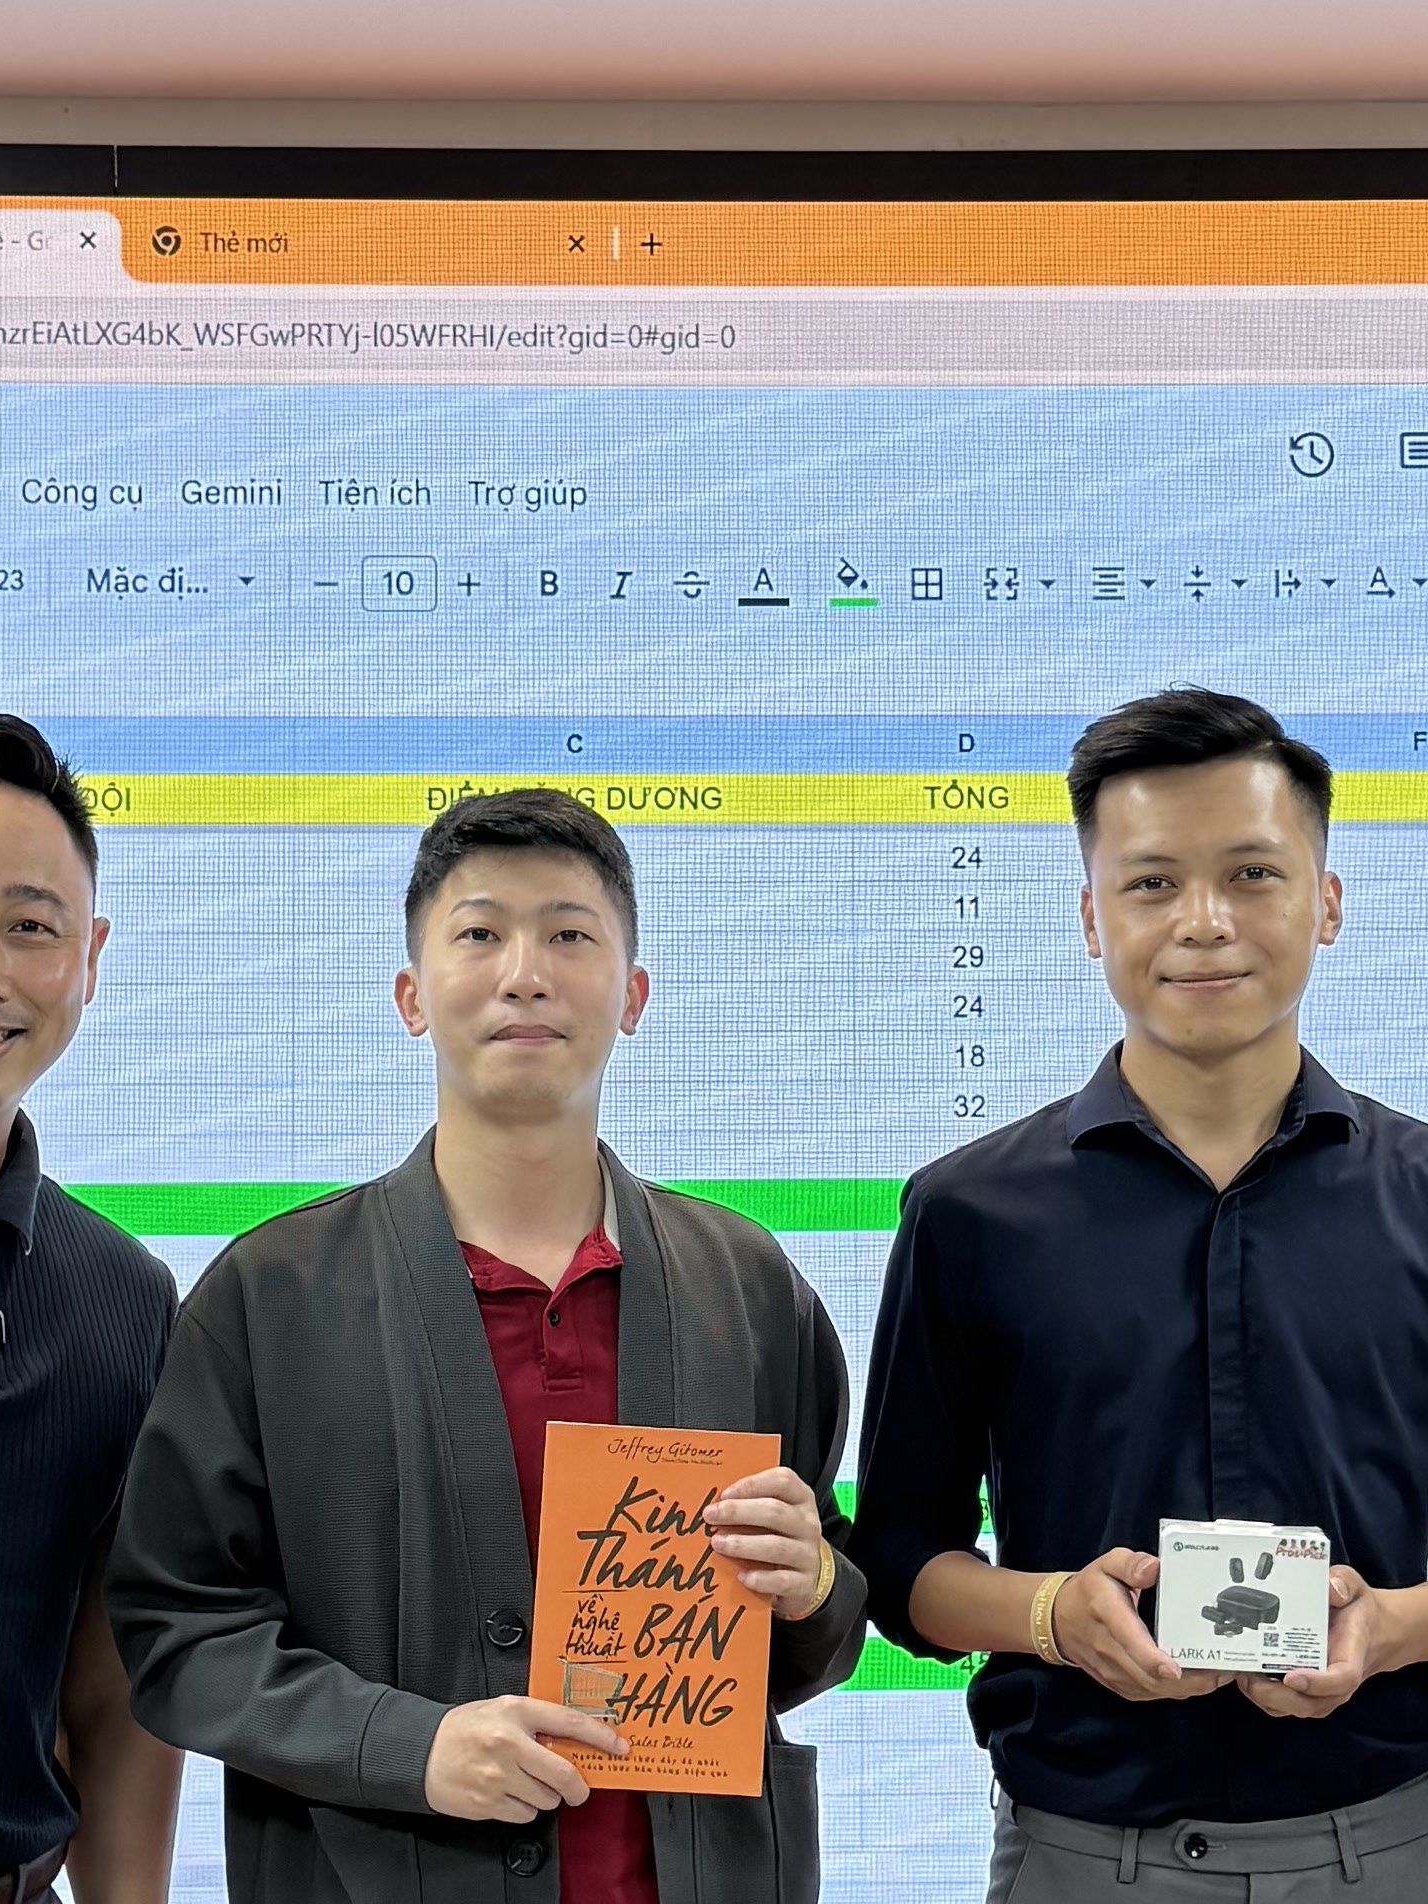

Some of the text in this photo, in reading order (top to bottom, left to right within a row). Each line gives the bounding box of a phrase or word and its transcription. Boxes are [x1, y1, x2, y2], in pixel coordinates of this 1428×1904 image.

[200, 230, 288, 253] Thẻ mới
[22, 479, 142, 511] Công cụ
[182, 480, 282, 505] Gemini
[320, 480, 431, 512] Tiện ích
[470, 481, 587, 512] Trợ giúp
[86, 568, 148, 601] Mặc
[382, 572, 414, 595] 10
[607, 786, 722, 810] DƯƠNG
[924, 779, 1009, 809] TỔNG
[951, 847, 982, 869] 24
[954, 898, 980, 918] 11
[952, 947, 984, 969] 29
[953, 996, 985, 1019] 24
[955, 1046, 985, 1068] 18
[954, 1096, 986, 1119] 32
[607, 1436, 663, 1463] Jeffrey
[606, 1476, 719, 1537] Kinh
[577, 1530, 720, 1594] Thánh
[578, 1594, 603, 1614] về
[572, 1608, 620, 1645] nghệ
[634, 1594, 746, 1663] BÁN
[565, 1630, 627, 1660] thuật
[1171, 1648, 1204, 1659] LARK
[605, 1663, 738, 1727] HÀNG
